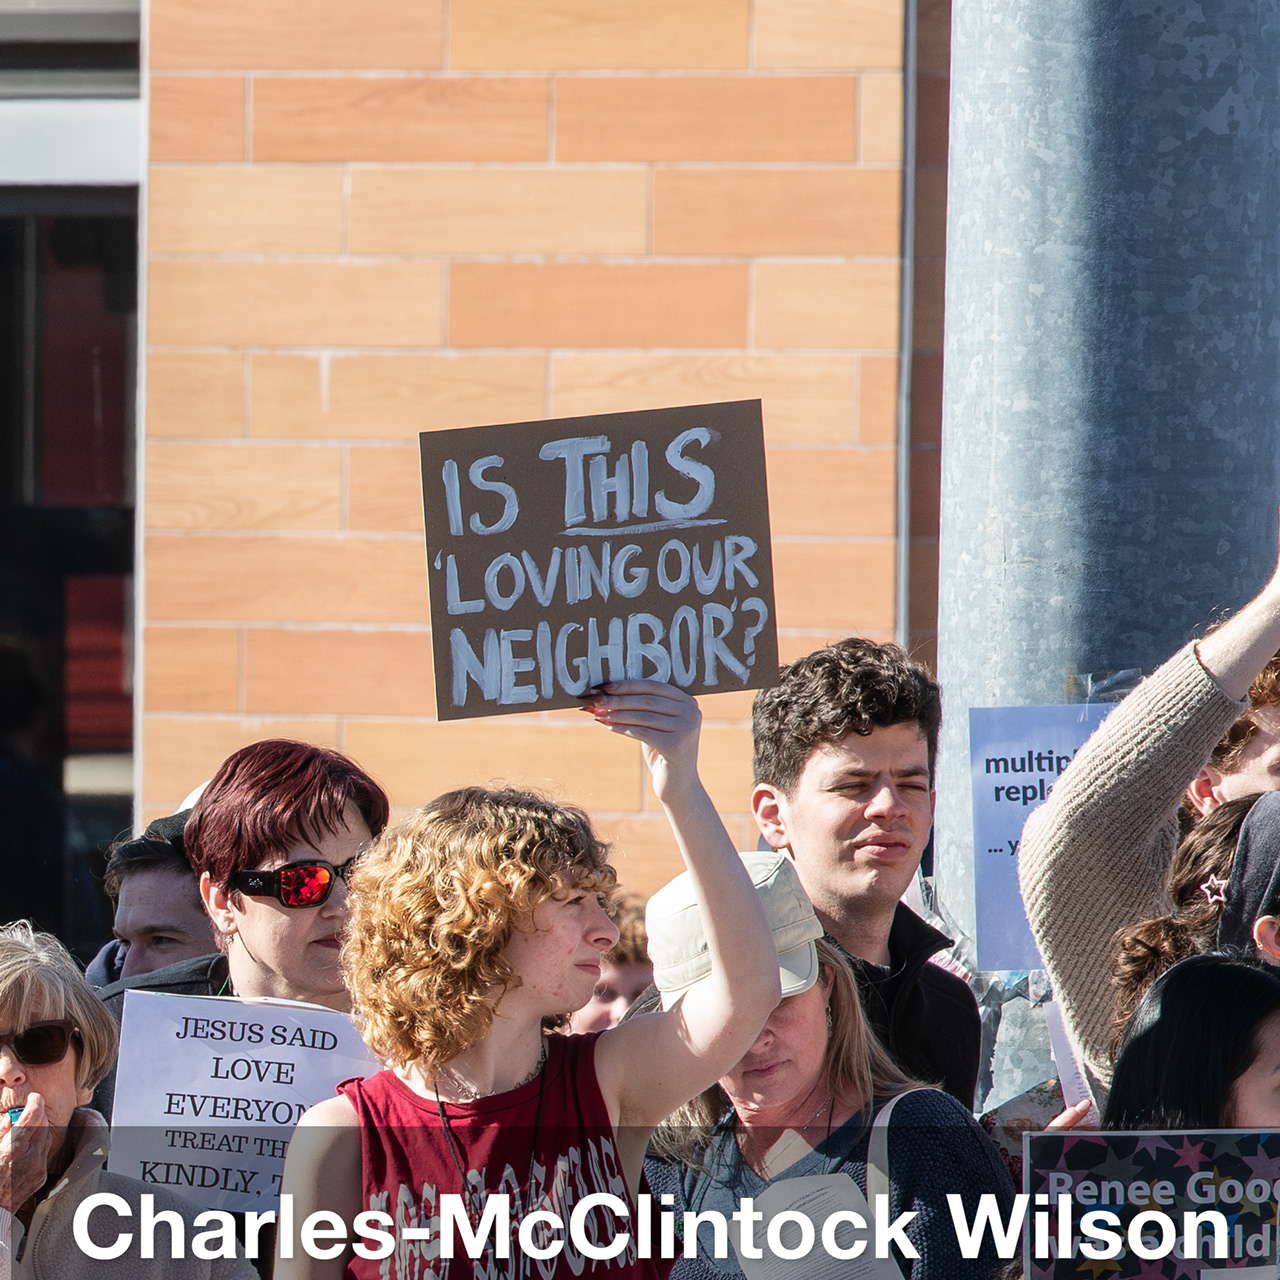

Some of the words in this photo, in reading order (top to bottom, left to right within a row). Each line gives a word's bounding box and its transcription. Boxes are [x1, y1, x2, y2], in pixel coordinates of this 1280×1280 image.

[442, 454, 521, 537] IS
[538, 427, 721, 528] THIS
[656, 534, 760, 596] OUR
[985, 749, 1077, 777] multip
[994, 778, 1054, 806] repl
[176, 1016, 265, 1044] JESUS
[270, 1023, 339, 1051] SAID
[210, 1056, 296, 1085] LOVE
[163, 1092, 312, 1126] EVERYON
[164, 1129, 249, 1154] TREAT
[253, 1137, 289, 1159] TH
[139, 1160, 263, 1198] KINDLY,
[1048, 1172, 1176, 1206] Renee
